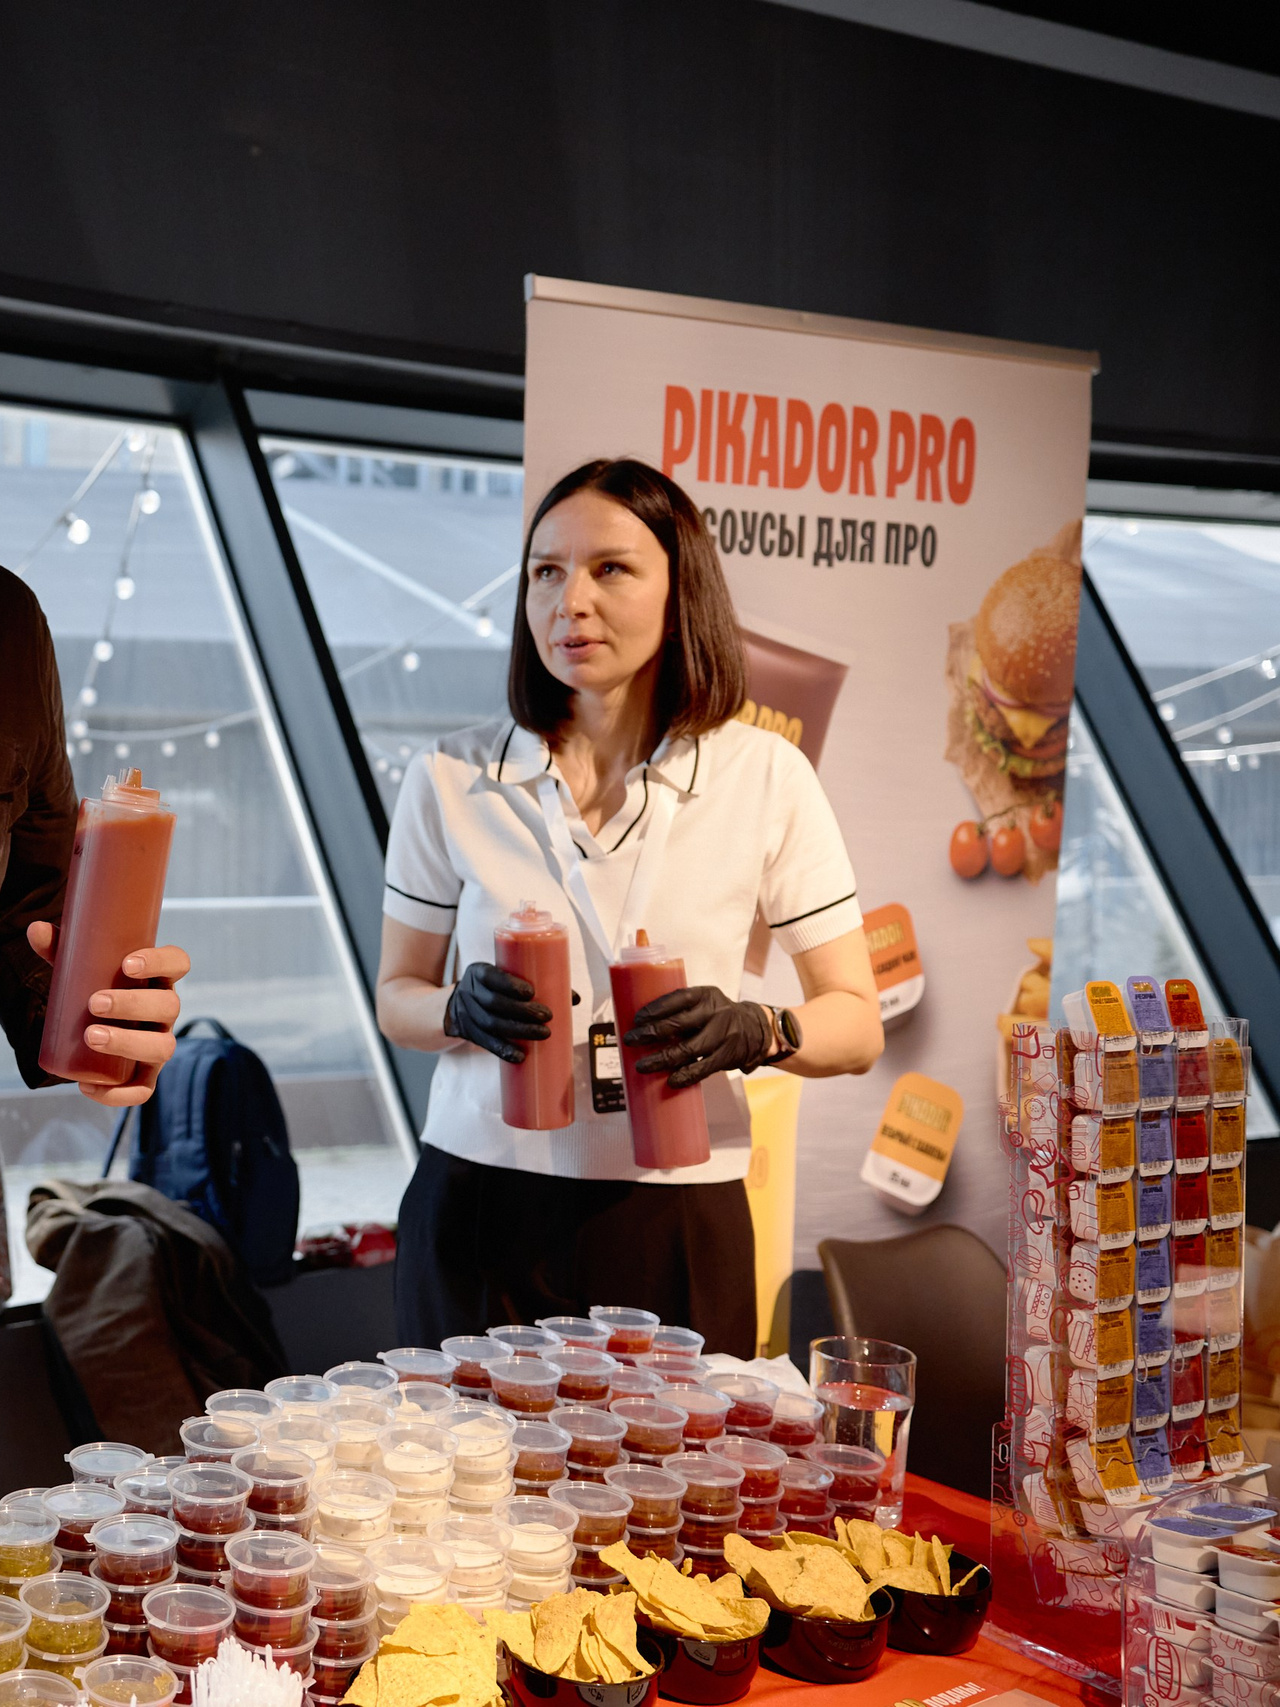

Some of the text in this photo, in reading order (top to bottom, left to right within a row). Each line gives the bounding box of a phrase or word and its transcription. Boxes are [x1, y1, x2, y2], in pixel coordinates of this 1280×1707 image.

[662, 384, 977, 506] PIKADOR PRO
[701, 507, 938, 569] СОУСЫ ДЛЯ ПРО
